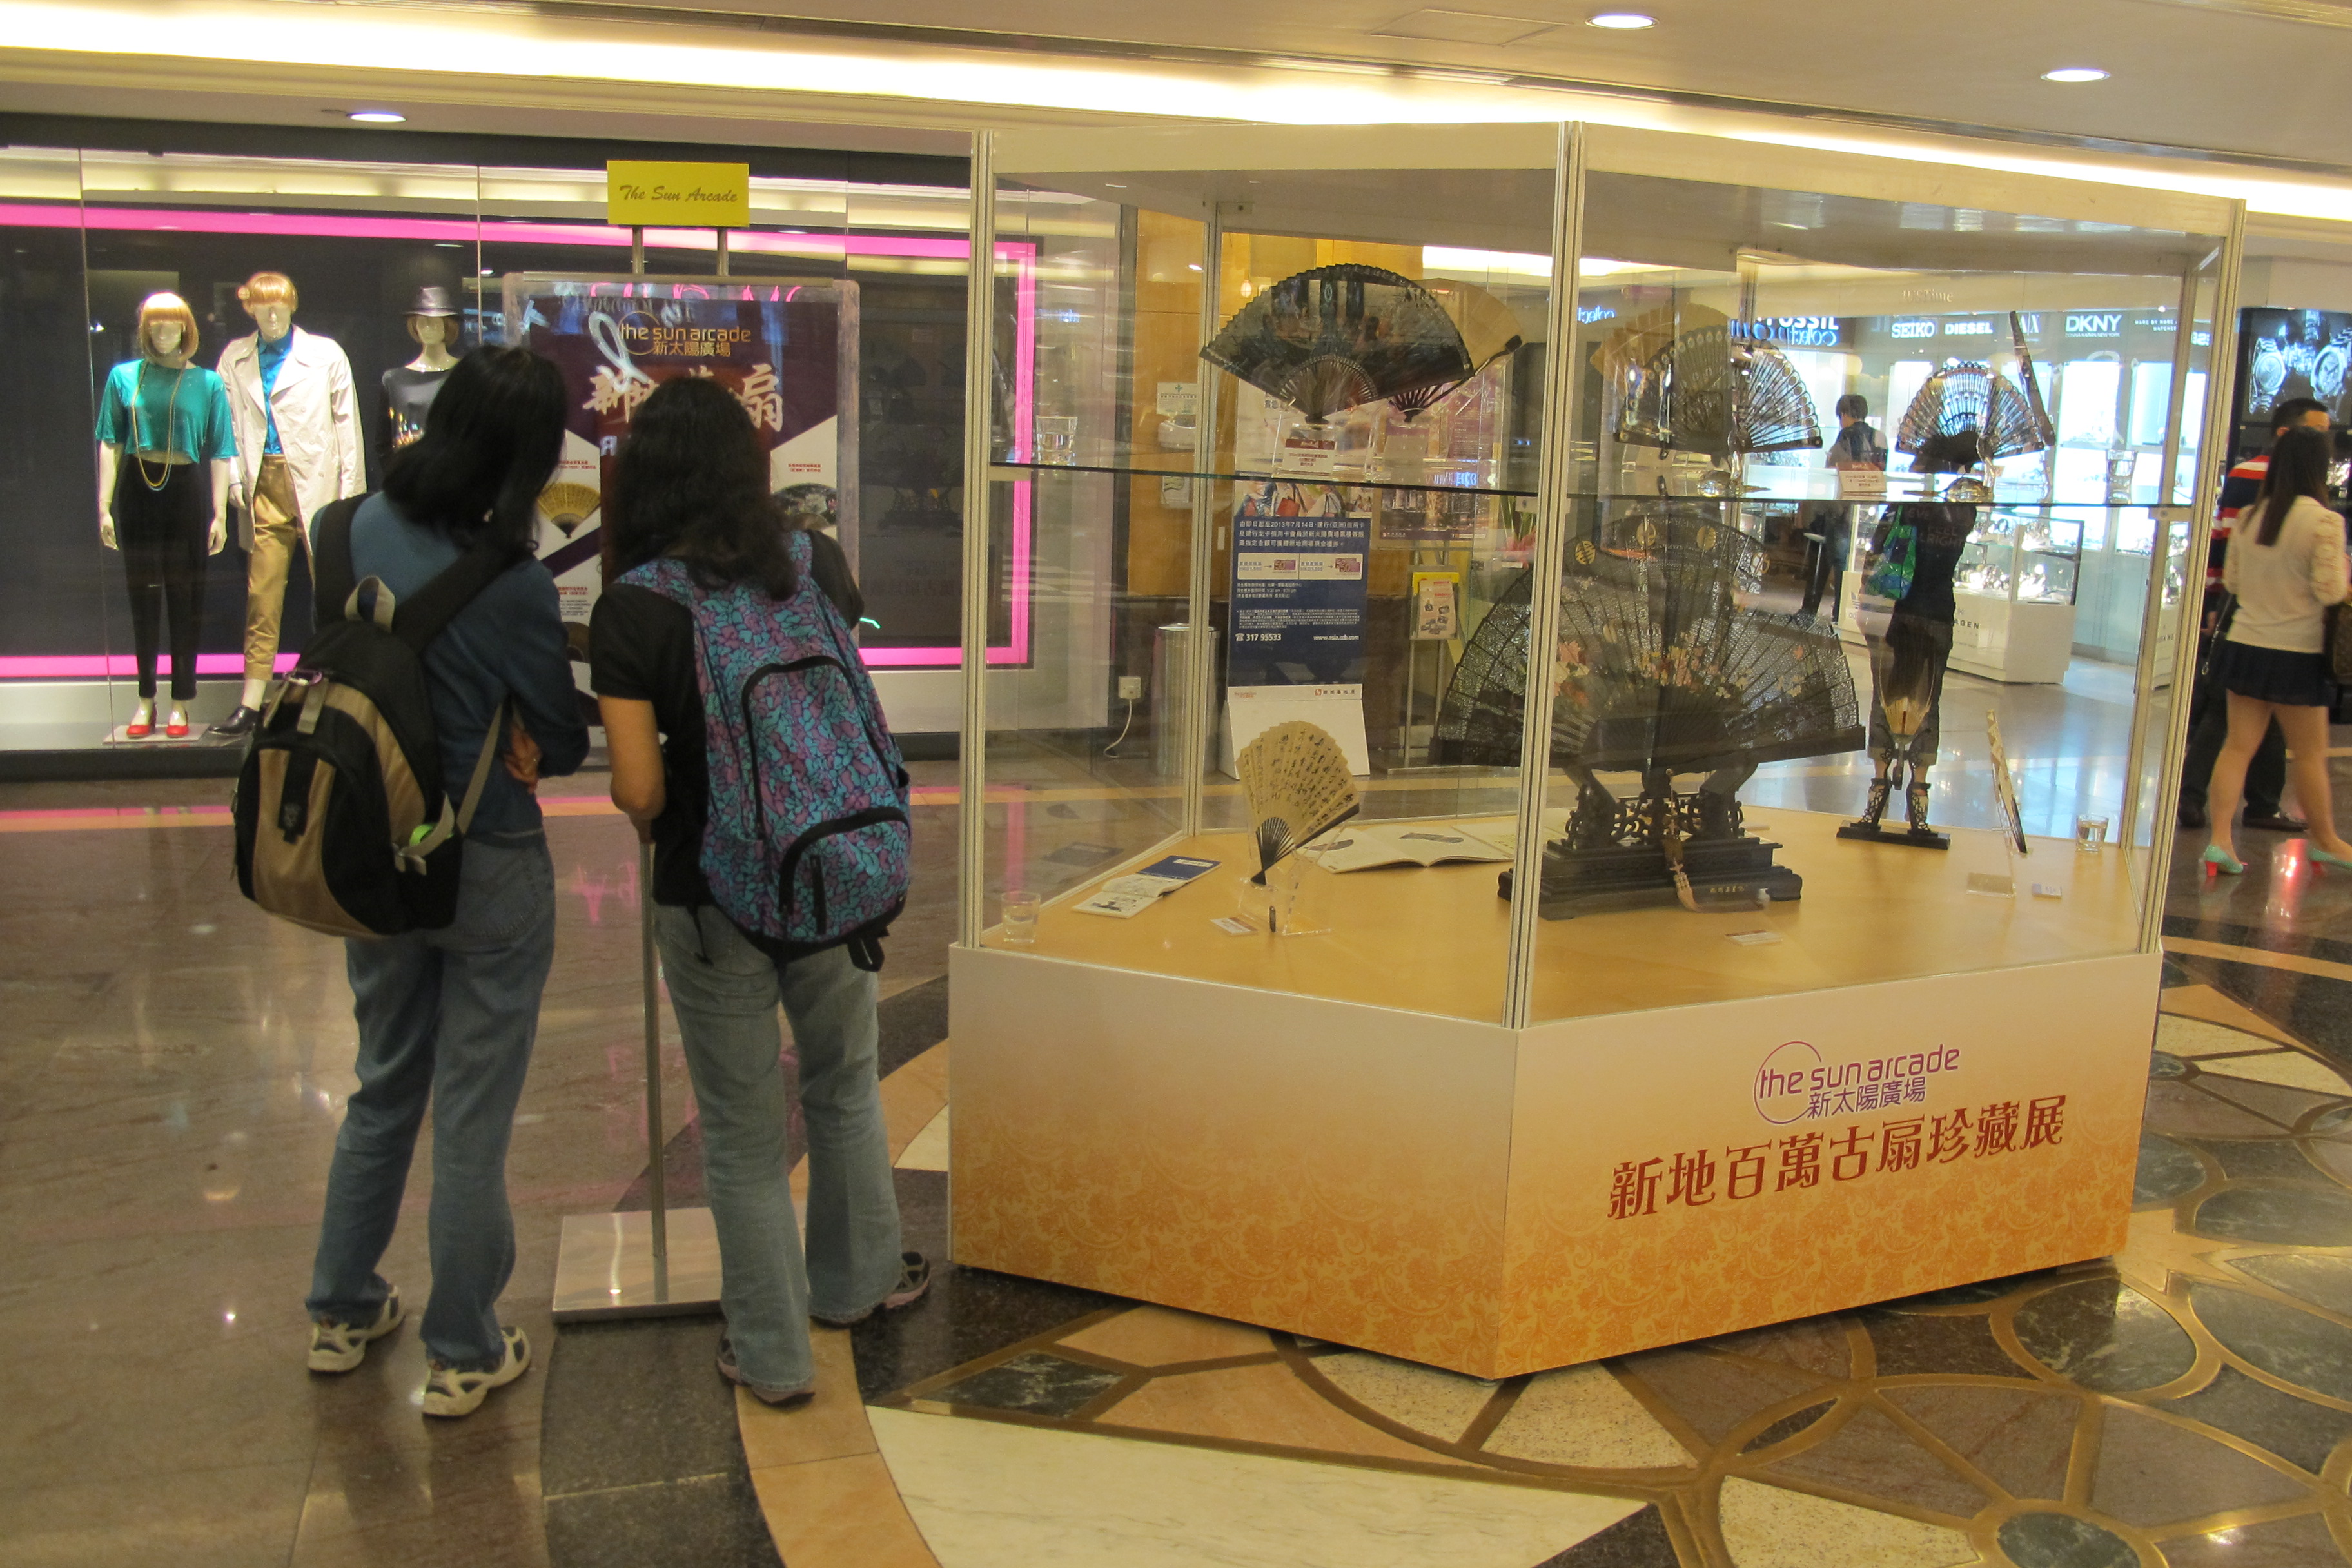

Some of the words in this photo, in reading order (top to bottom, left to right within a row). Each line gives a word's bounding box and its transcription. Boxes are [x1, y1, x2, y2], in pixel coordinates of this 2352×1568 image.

[620, 185, 645, 201] The
[651, 186, 681, 201] Sun
[685, 187, 738, 202] Arcade
[1891, 321, 1935, 338] SEIKO
[1945, 322, 1994, 335] DIESEL
[2065, 315, 2122, 332] DKNY
[620, 324, 649, 340] the
[653, 327, 686, 341] sun
[690, 326, 752, 342] arcade
[652, 341, 731, 357] 新太陽廣場
[1759, 1068, 1804, 1099] the
[1809, 1063, 1862, 1092] sun
[1867, 1043, 1961, 1082] arcade
[1807, 1076, 1926, 1119] 新太陽廣場
[1607, 1093, 2067, 1221] 新地百萬古扇珍藏展
